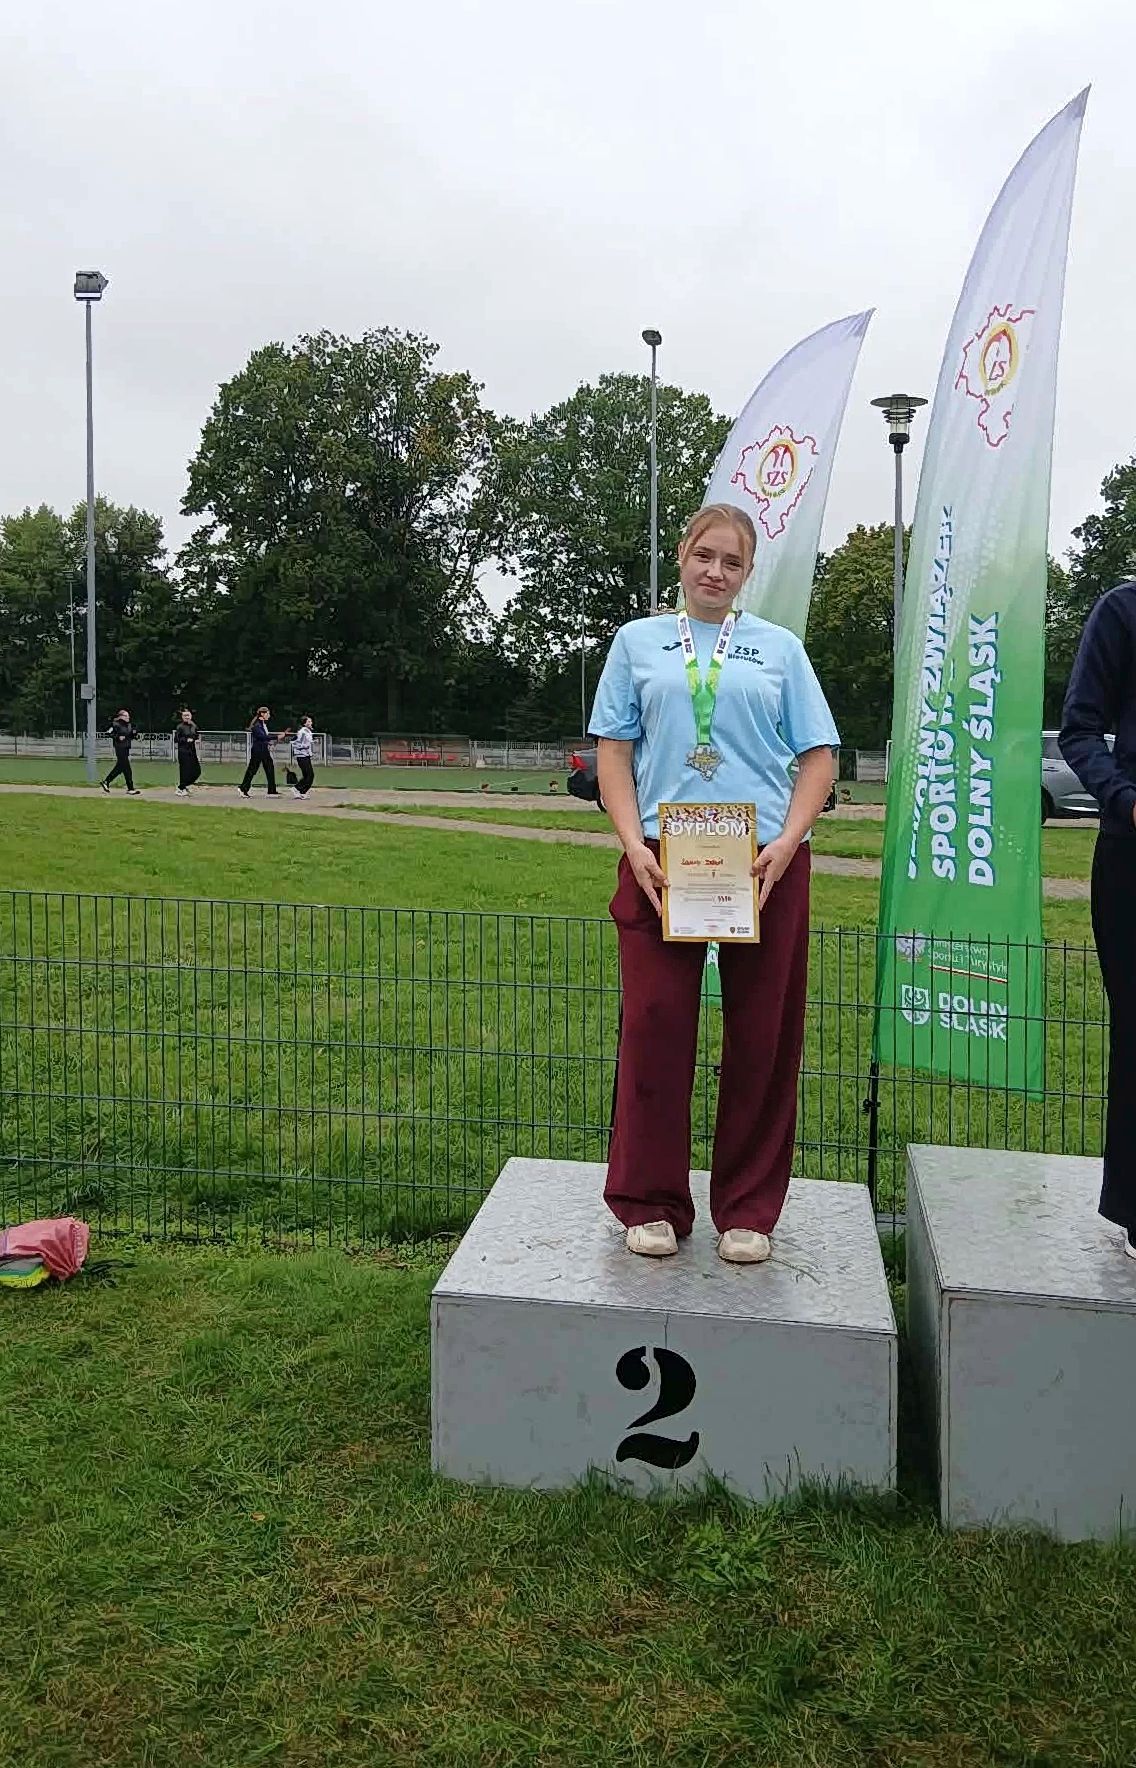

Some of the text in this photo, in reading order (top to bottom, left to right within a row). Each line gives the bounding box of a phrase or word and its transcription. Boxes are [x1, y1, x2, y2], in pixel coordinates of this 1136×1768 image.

[764, 470, 789, 487] SZS
[735, 645, 760, 657] ZSP
[929, 657, 957, 882] SPORTOW
[962, 612, 1002, 887] DOLNY ŚLĄSK
[671, 819, 747, 836] DYPLOM
[616, 1345, 699, 1469] 2
